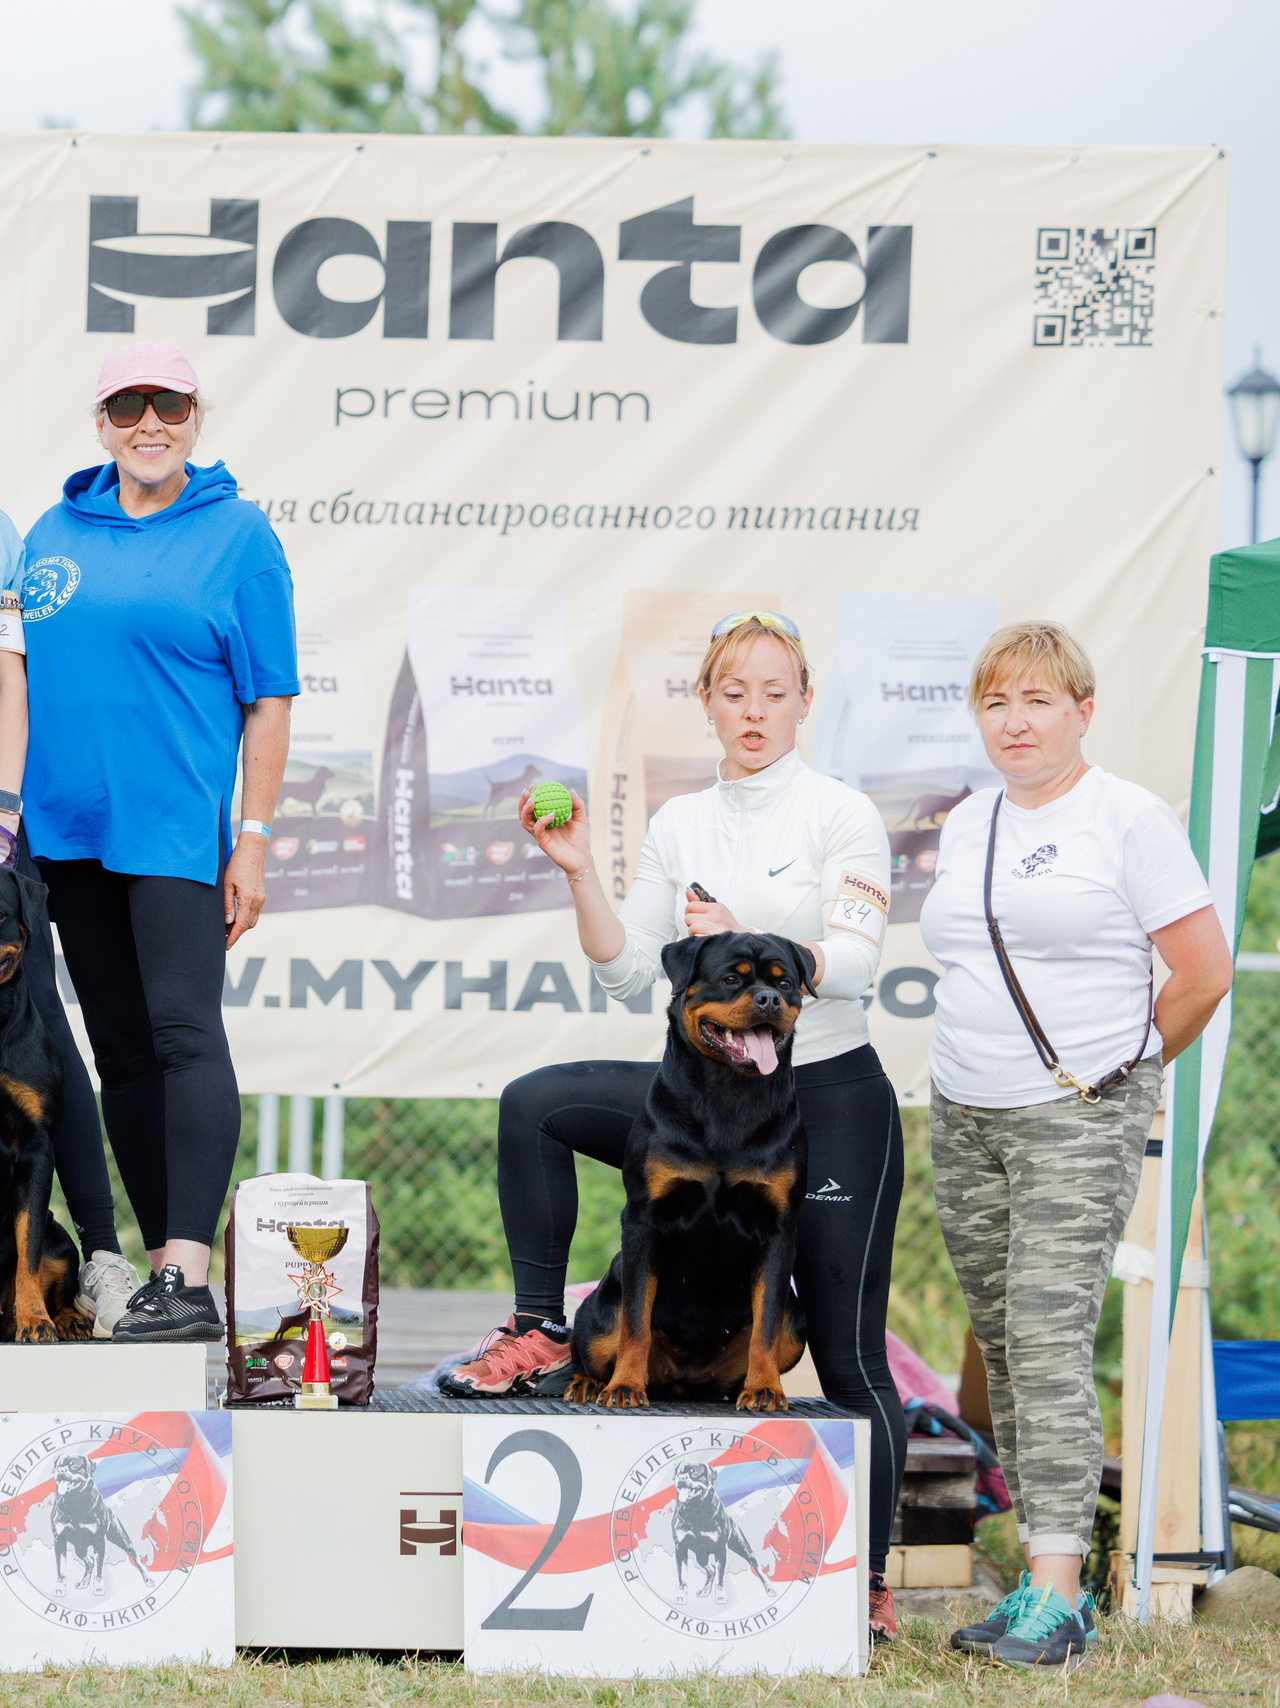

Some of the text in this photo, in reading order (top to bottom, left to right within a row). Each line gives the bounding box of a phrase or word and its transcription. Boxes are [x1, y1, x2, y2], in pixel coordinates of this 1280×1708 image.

[86, 195, 913, 346] Hanta
[336, 380, 650, 427] premium
[310, 488, 716, 536] сбалансированного
[727, 502, 920, 532] питания
[22, 605, 55, 620] WEILER
[450, 675, 553, 696] Hanta
[394, 768, 415, 900] Hanta
[610, 772, 627, 901] Hanta
[843, 900, 871, 924] 84
[844, 875, 888, 908] Hanta
[804, 1193, 853, 1202] DEMIX
[89, 1425, 160, 1457] КЛУБ
[165, 1462, 200, 1575] РОССИИ
[614, 1433, 821, 1586] РОТВЕЙЛЕР КЛУБ РОССИИ
[480, 1429, 594, 1631] 2
[44, 1596, 157, 1628] РКФ-НКПР
[665, 1606, 779, 1637] РКФ-НКПР
